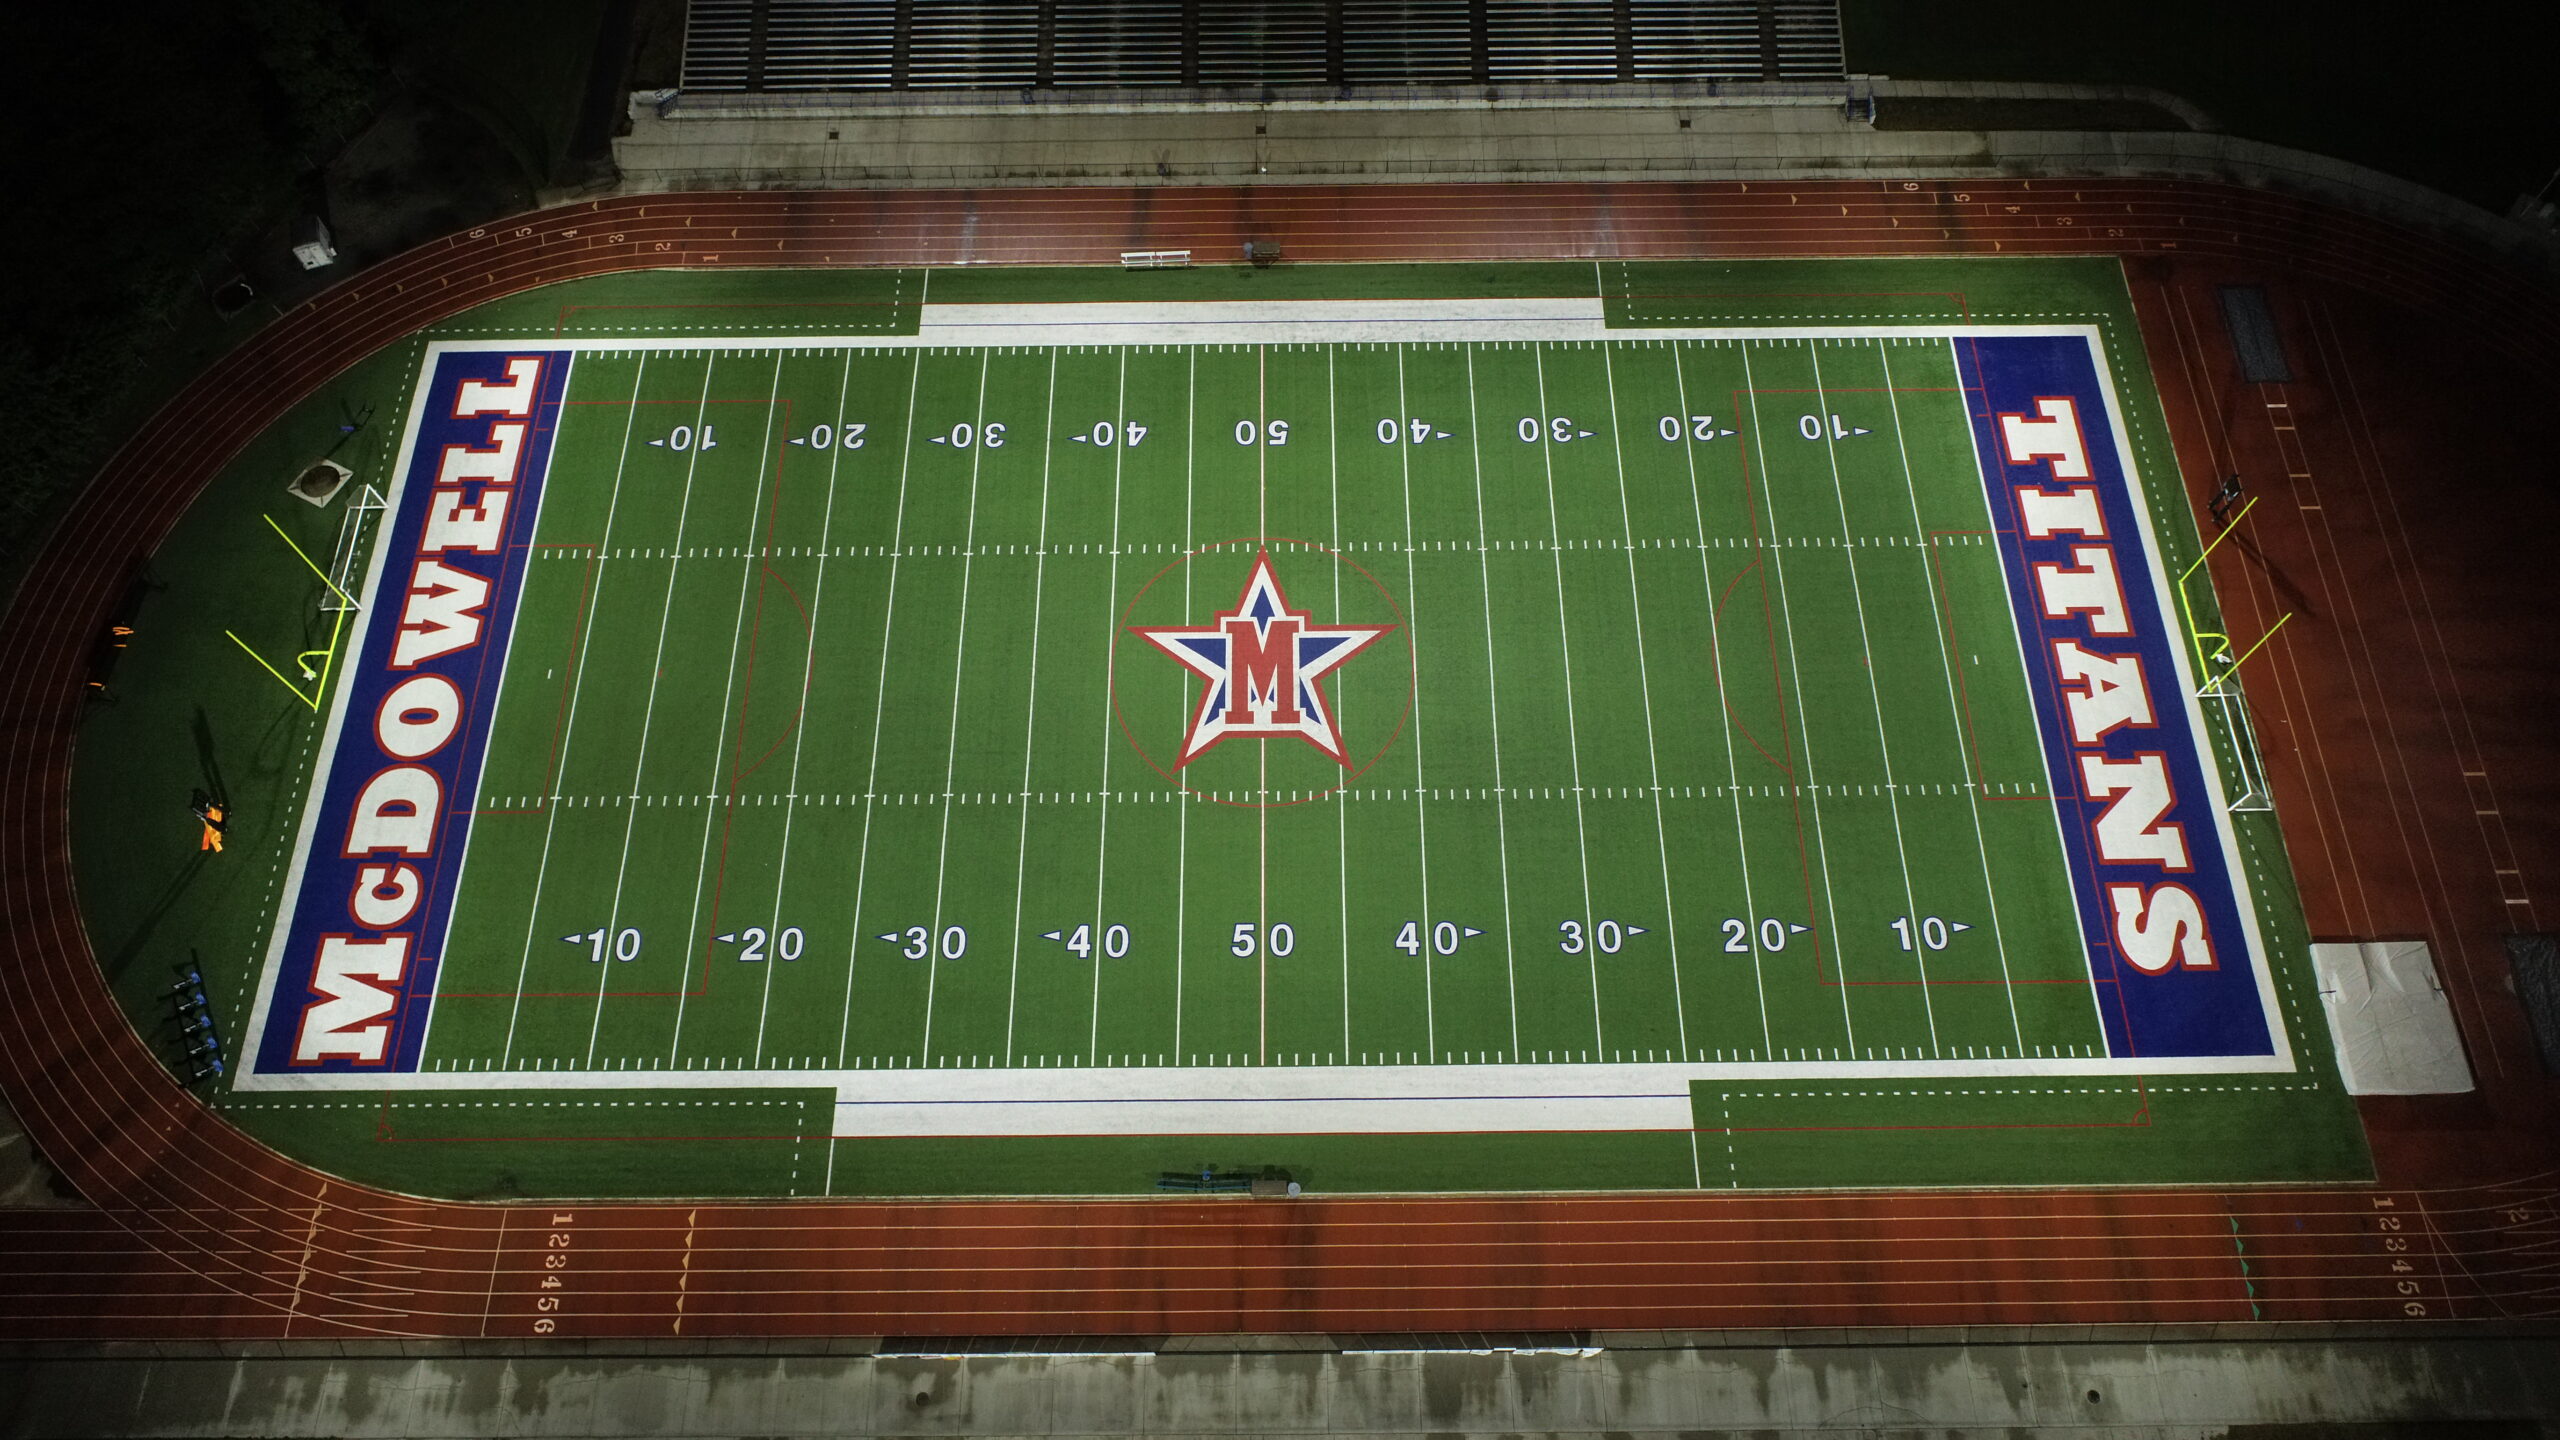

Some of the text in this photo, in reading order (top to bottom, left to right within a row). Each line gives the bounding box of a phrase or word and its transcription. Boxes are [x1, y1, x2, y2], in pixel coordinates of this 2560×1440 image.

[1903, 182, 1919, 192] 6
[1953, 193, 1970, 202] 5
[2004, 205, 2021, 214] 4
[2056, 216, 2072, 226] 3
[469, 228, 485, 239] 6
[516, 227, 533, 238] 5
[561, 229, 578, 239] 4
[609, 233, 625, 243] 3
[2107, 228, 2124, 238] 2
[655, 242, 671, 251] 2
[2160, 241, 2176, 249] 1
[703, 254, 719, 262] 1
[1091, 421, 1148, 447] 40
[1234, 419, 1289, 446] 50
[1376, 417, 1431, 444] 40
[1517, 416, 1573, 443] 30
[1658, 415, 1714, 442] 20
[1800, 413, 1849, 441] 10
[669, 425, 717, 452] 10
[810, 422, 867, 450] 20
[951, 422, 1007, 449] 30
[1221, 617, 1304, 728] M
[1997, 396, 2219, 976] TITANS
[1065, 924, 1130, 959] 40
[1230, 922, 1295, 958] 50
[1395, 921, 1460, 956] 40
[1559, 919, 1623, 955] 30
[1721, 918, 1786, 953] 20
[1890, 916, 1949, 952] 10
[586, 927, 642, 963] 10
[738, 926, 805, 962] 20
[902, 925, 968, 961] 30
[2372, 1197, 2395, 1209] 1
[552, 1213, 573, 1226] 1
[2507, 1207, 2529, 1223] 2
[2379, 1217, 2400, 1231] 2
[549, 1234, 570, 1247] 2
[2385, 1238, 2407, 1251] 3
[545, 1255, 566, 1269] 3
[2391, 1259, 2414, 1273] 4
[541, 1275, 562, 1289] 4
[2397, 1280, 2421, 1295] 5
[537, 1297, 559, 1311] 5
[2403, 1302, 2426, 1317] 6
[533, 1318, 555, 1333] 6
